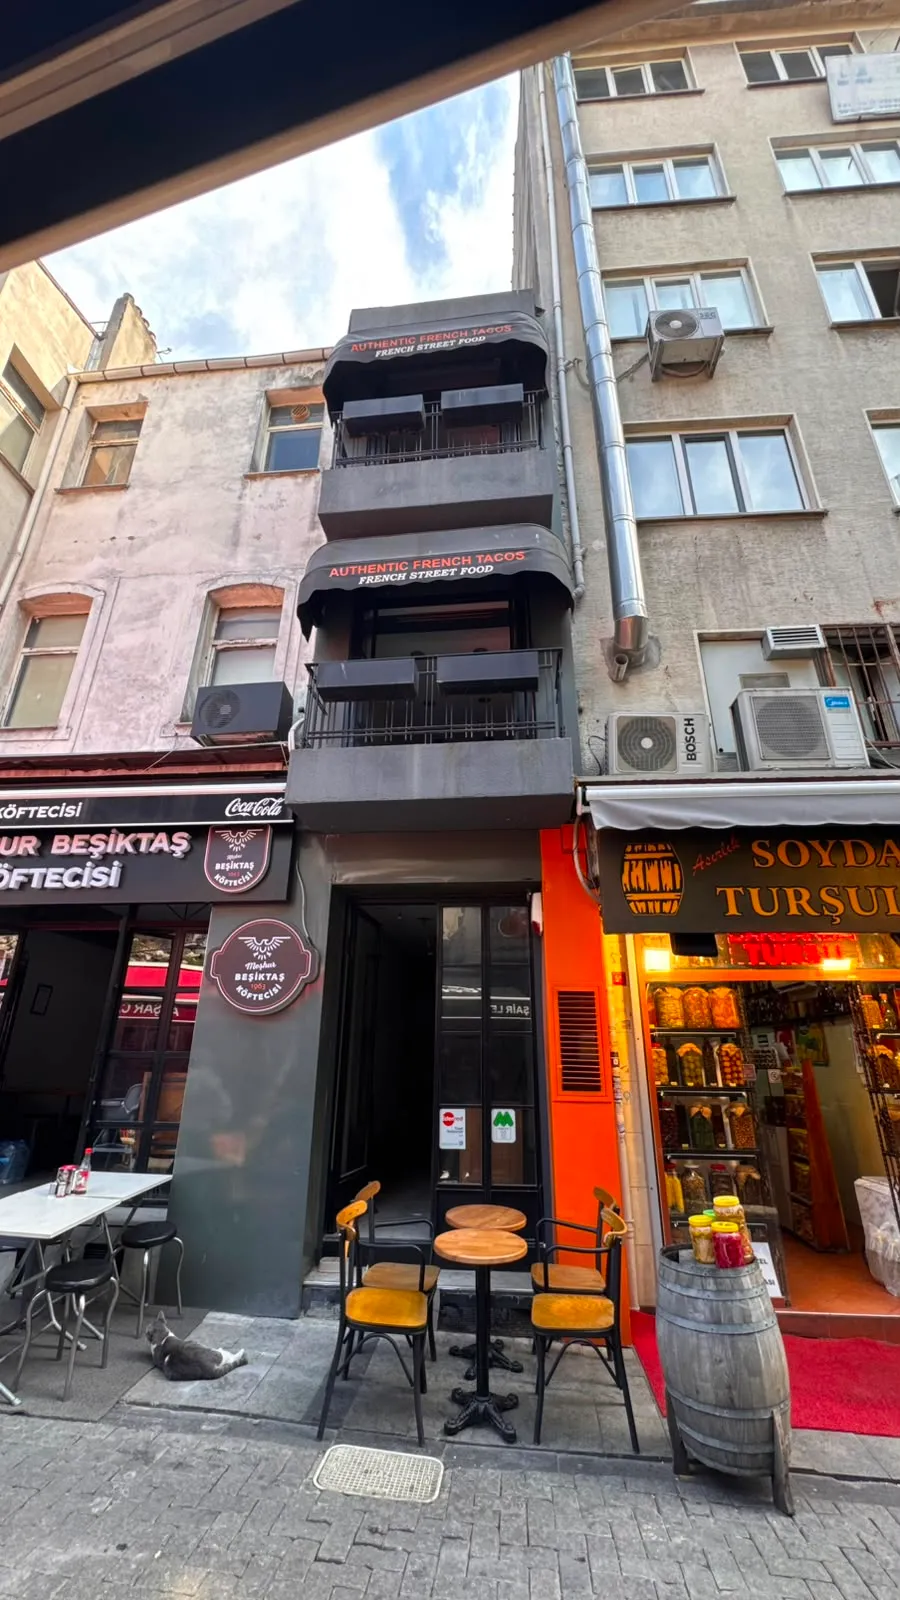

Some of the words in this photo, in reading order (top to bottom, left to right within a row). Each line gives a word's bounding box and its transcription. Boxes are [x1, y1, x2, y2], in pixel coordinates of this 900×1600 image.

[351, 338, 416, 352] AUTHENTIC
[420, 330, 470, 343] FRENCH
[472, 324, 512, 336] TACOS
[375, 346, 414, 357] FRENCH
[416, 340, 456, 351] STREET
[458, 335, 486, 345] FOOD
[329, 562, 409, 577] AUTHENTIC
[413, 556, 472, 569] FRENCH
[476, 551, 525, 563] TACOS
[358, 572, 406, 585] FRENCH
[409, 568, 457, 580] STREET
[460, 565, 494, 574] FOOD
[684, 718, 697, 761] BOSCH
[225, 797, 284, 817] Coca-Cola
[51, 829, 191, 859] BEŞİKTAŞ
[215, 861, 255, 871] BEŞİKTAŞ
[214, 871, 253, 887] KÖFTECİSİ
[235, 973, 285, 982] BEŞİKTAŞ
[236, 983, 282, 1000] KÖFTECİSİ
